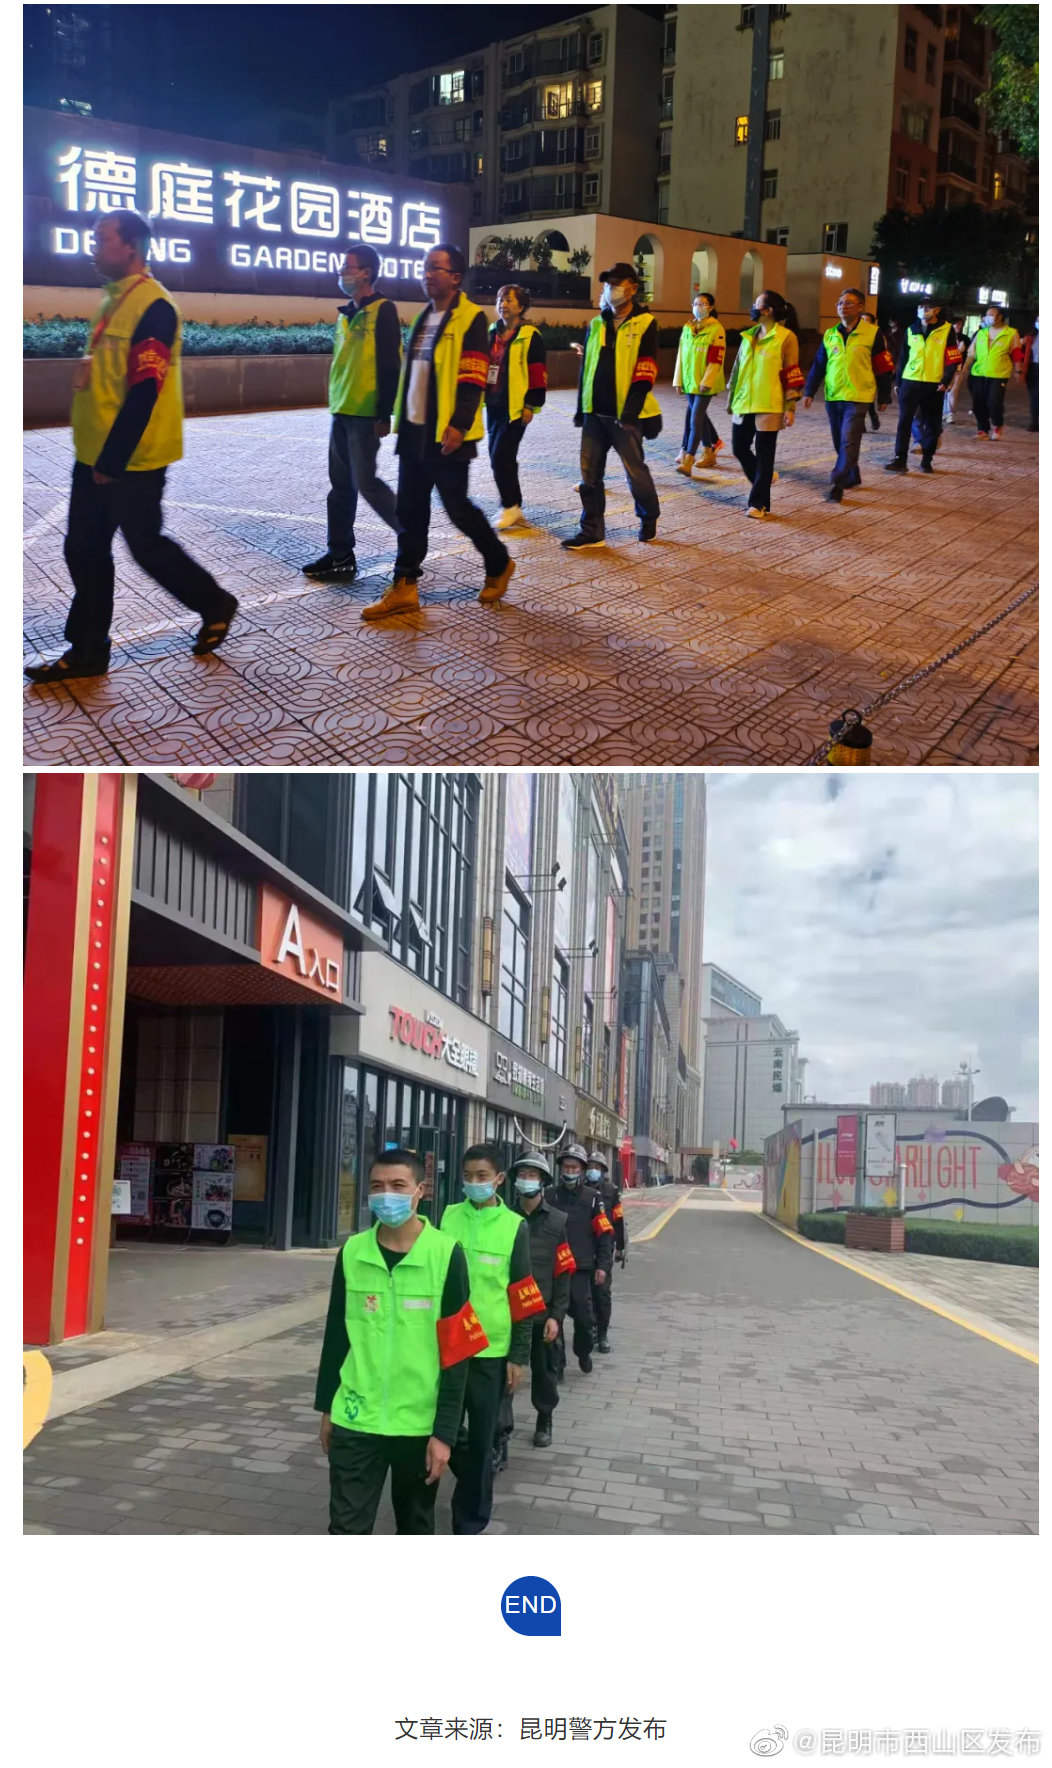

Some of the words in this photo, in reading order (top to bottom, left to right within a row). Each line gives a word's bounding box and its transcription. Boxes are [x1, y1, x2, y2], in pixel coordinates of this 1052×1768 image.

[57, 146, 441, 252] 德庭花园酒店
[55, 227, 191, 263] DENG
[231, 244, 346, 273] GARDEN
[378, 256, 425, 280] OTE
[391, 1005, 443, 1060] TOUCH
